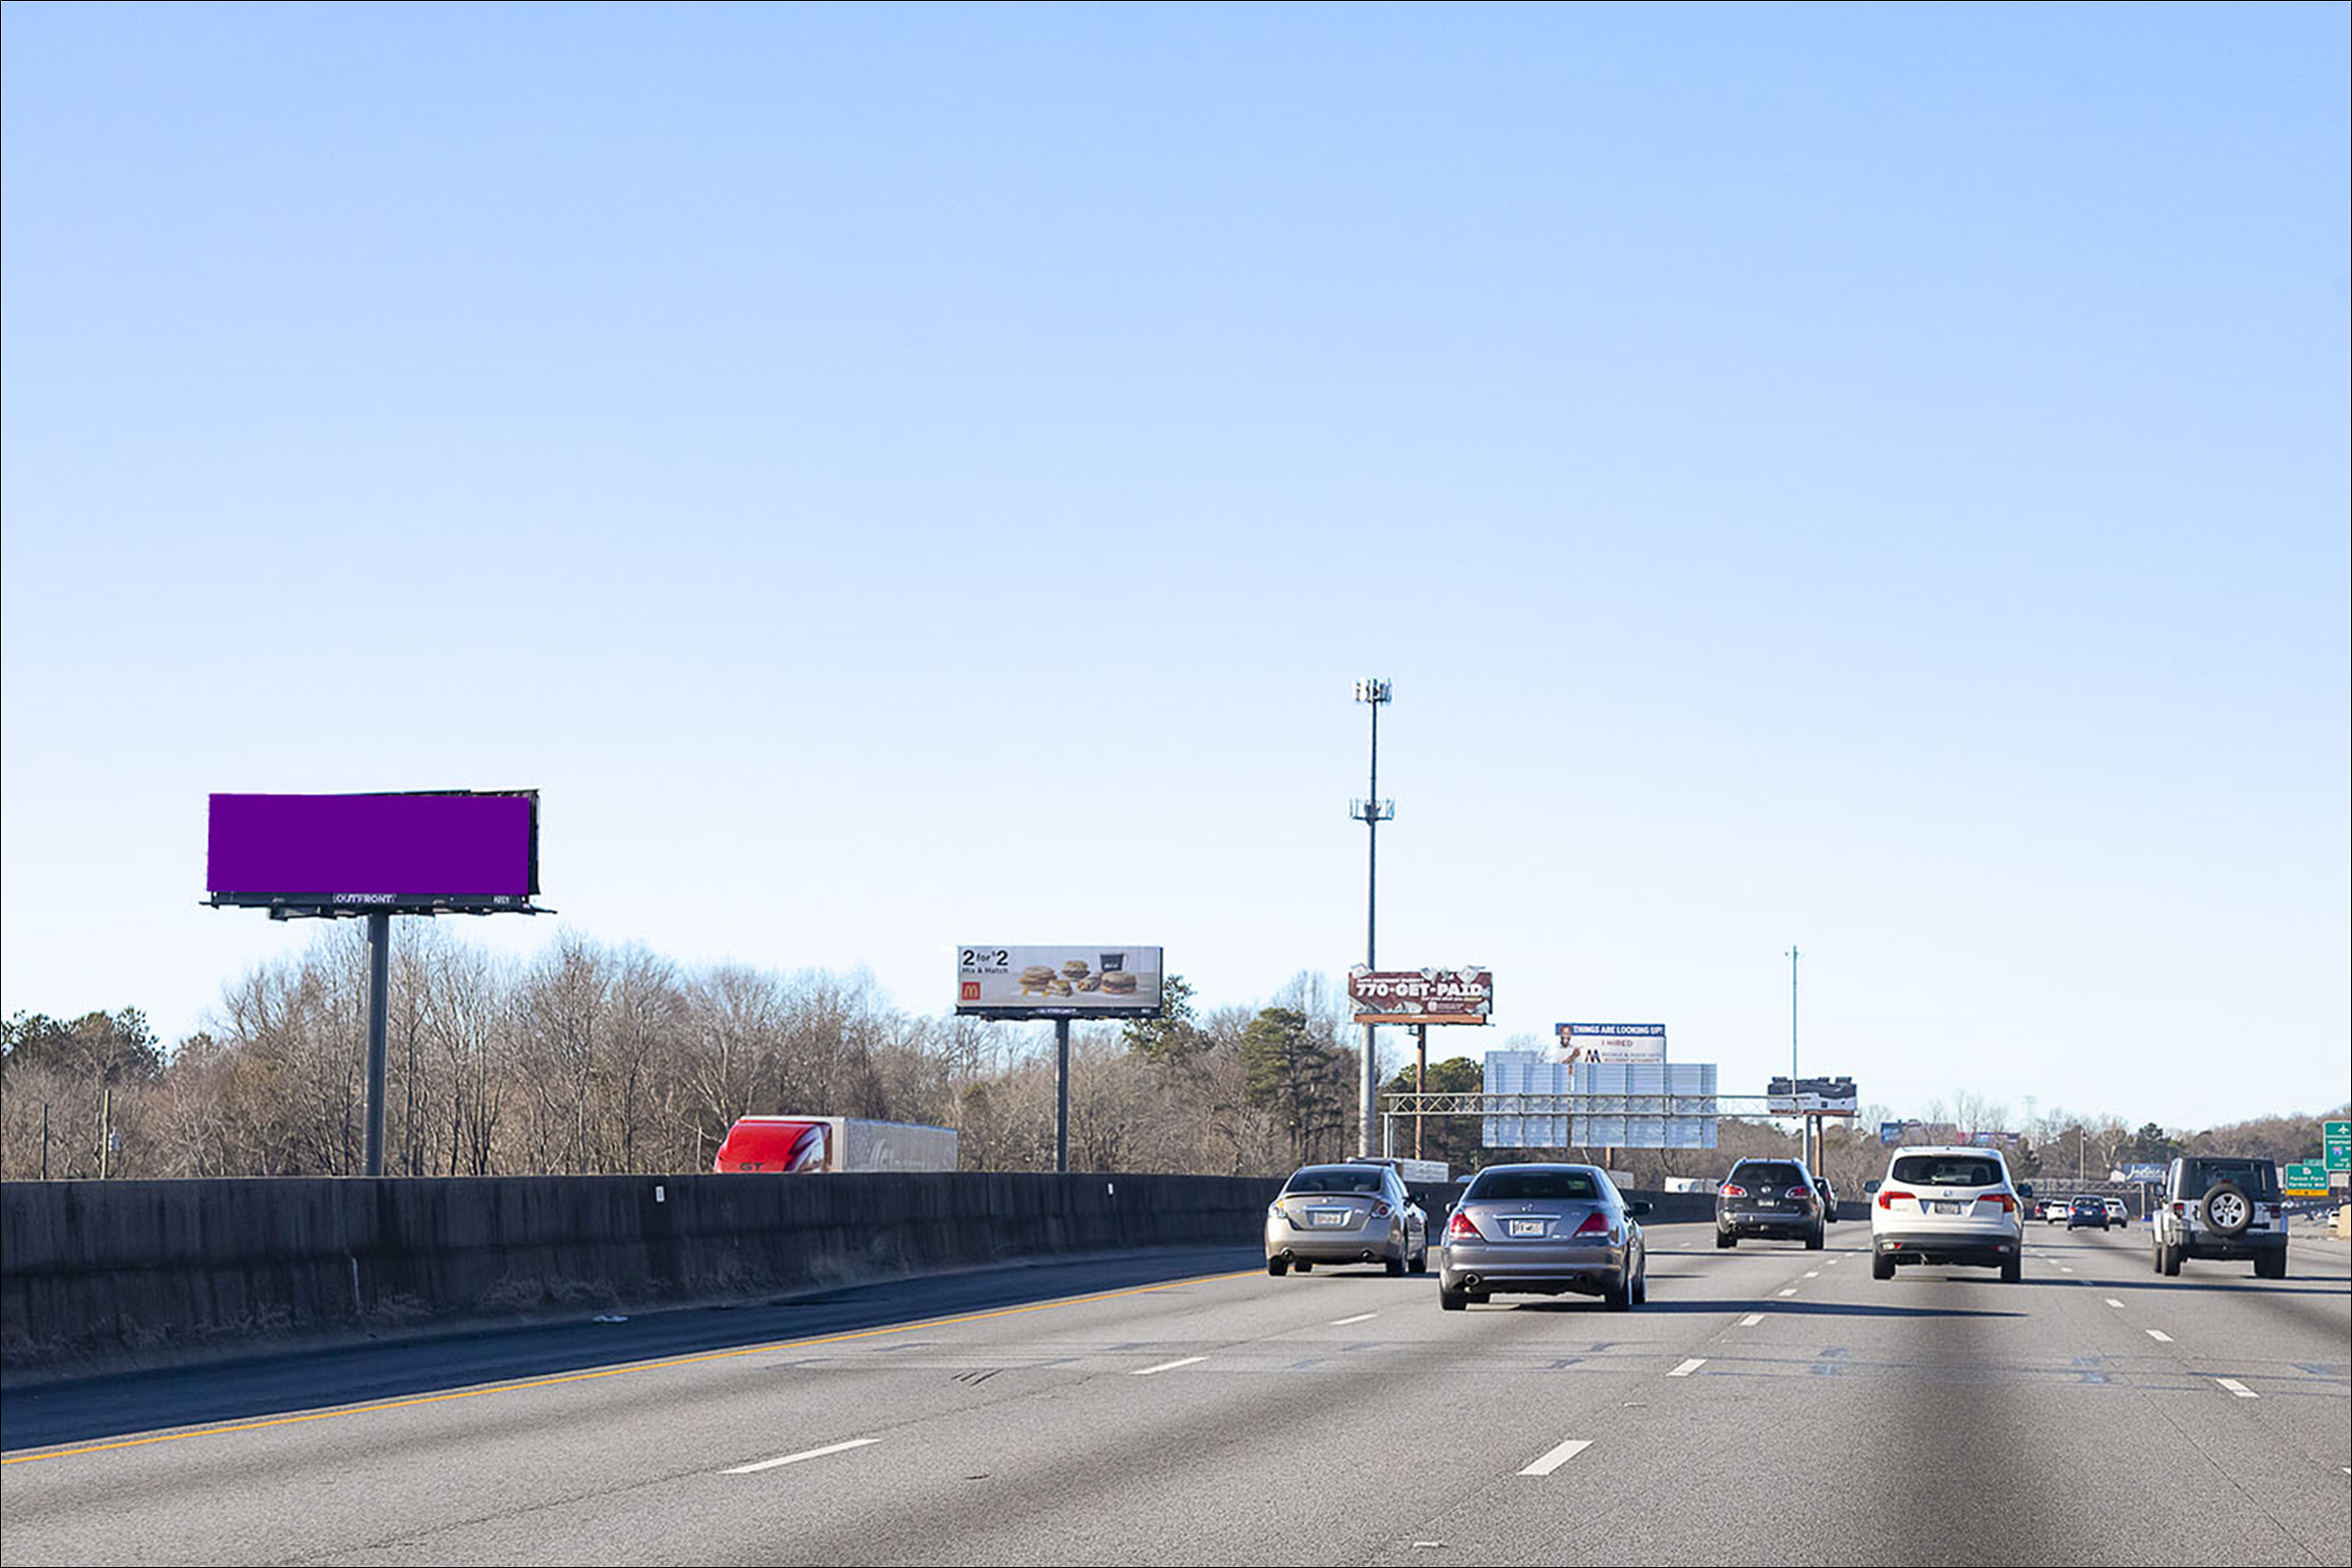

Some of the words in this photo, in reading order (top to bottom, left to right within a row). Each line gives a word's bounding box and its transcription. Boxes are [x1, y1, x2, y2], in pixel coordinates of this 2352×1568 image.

[962, 950, 975, 966] 2
[976, 953, 991, 962] for
[739, 1161, 764, 1171] GT
